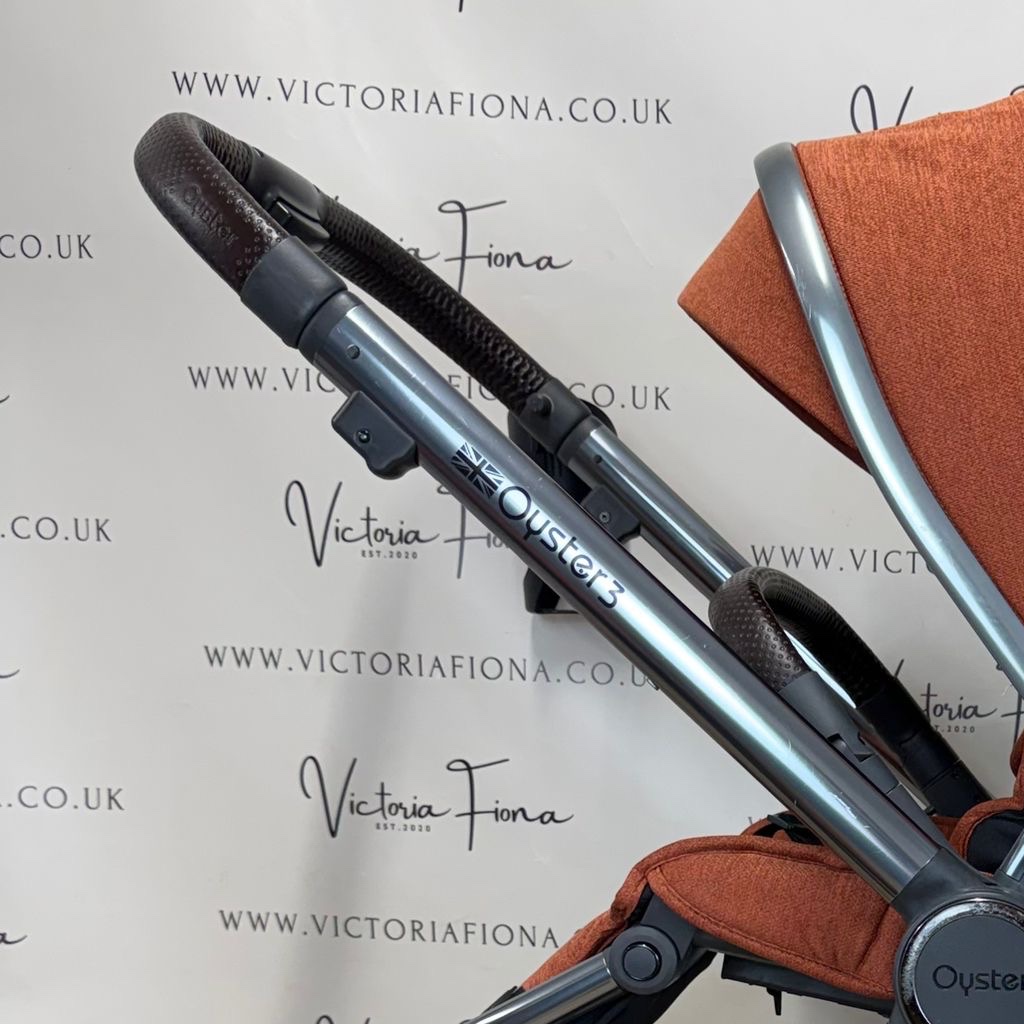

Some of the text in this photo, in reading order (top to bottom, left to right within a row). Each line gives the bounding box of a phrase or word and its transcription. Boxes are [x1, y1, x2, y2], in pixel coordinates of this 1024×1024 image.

[172, 71, 672, 124] WWW.VICTORIAFIONA.CO.UK
[438, 200, 573, 293] Fiona
[284, 481, 440, 568] Victoria
[361, 549, 418, 560] EST.2020
[204, 645, 650, 688] WWW.VICTORIAFIONA.CO.U
[299, 755, 574, 851] Victoria Fiona
[375, 822, 431, 833] EST.2020
[219, 910, 558, 948] WWW.VICTORIAFIONA
